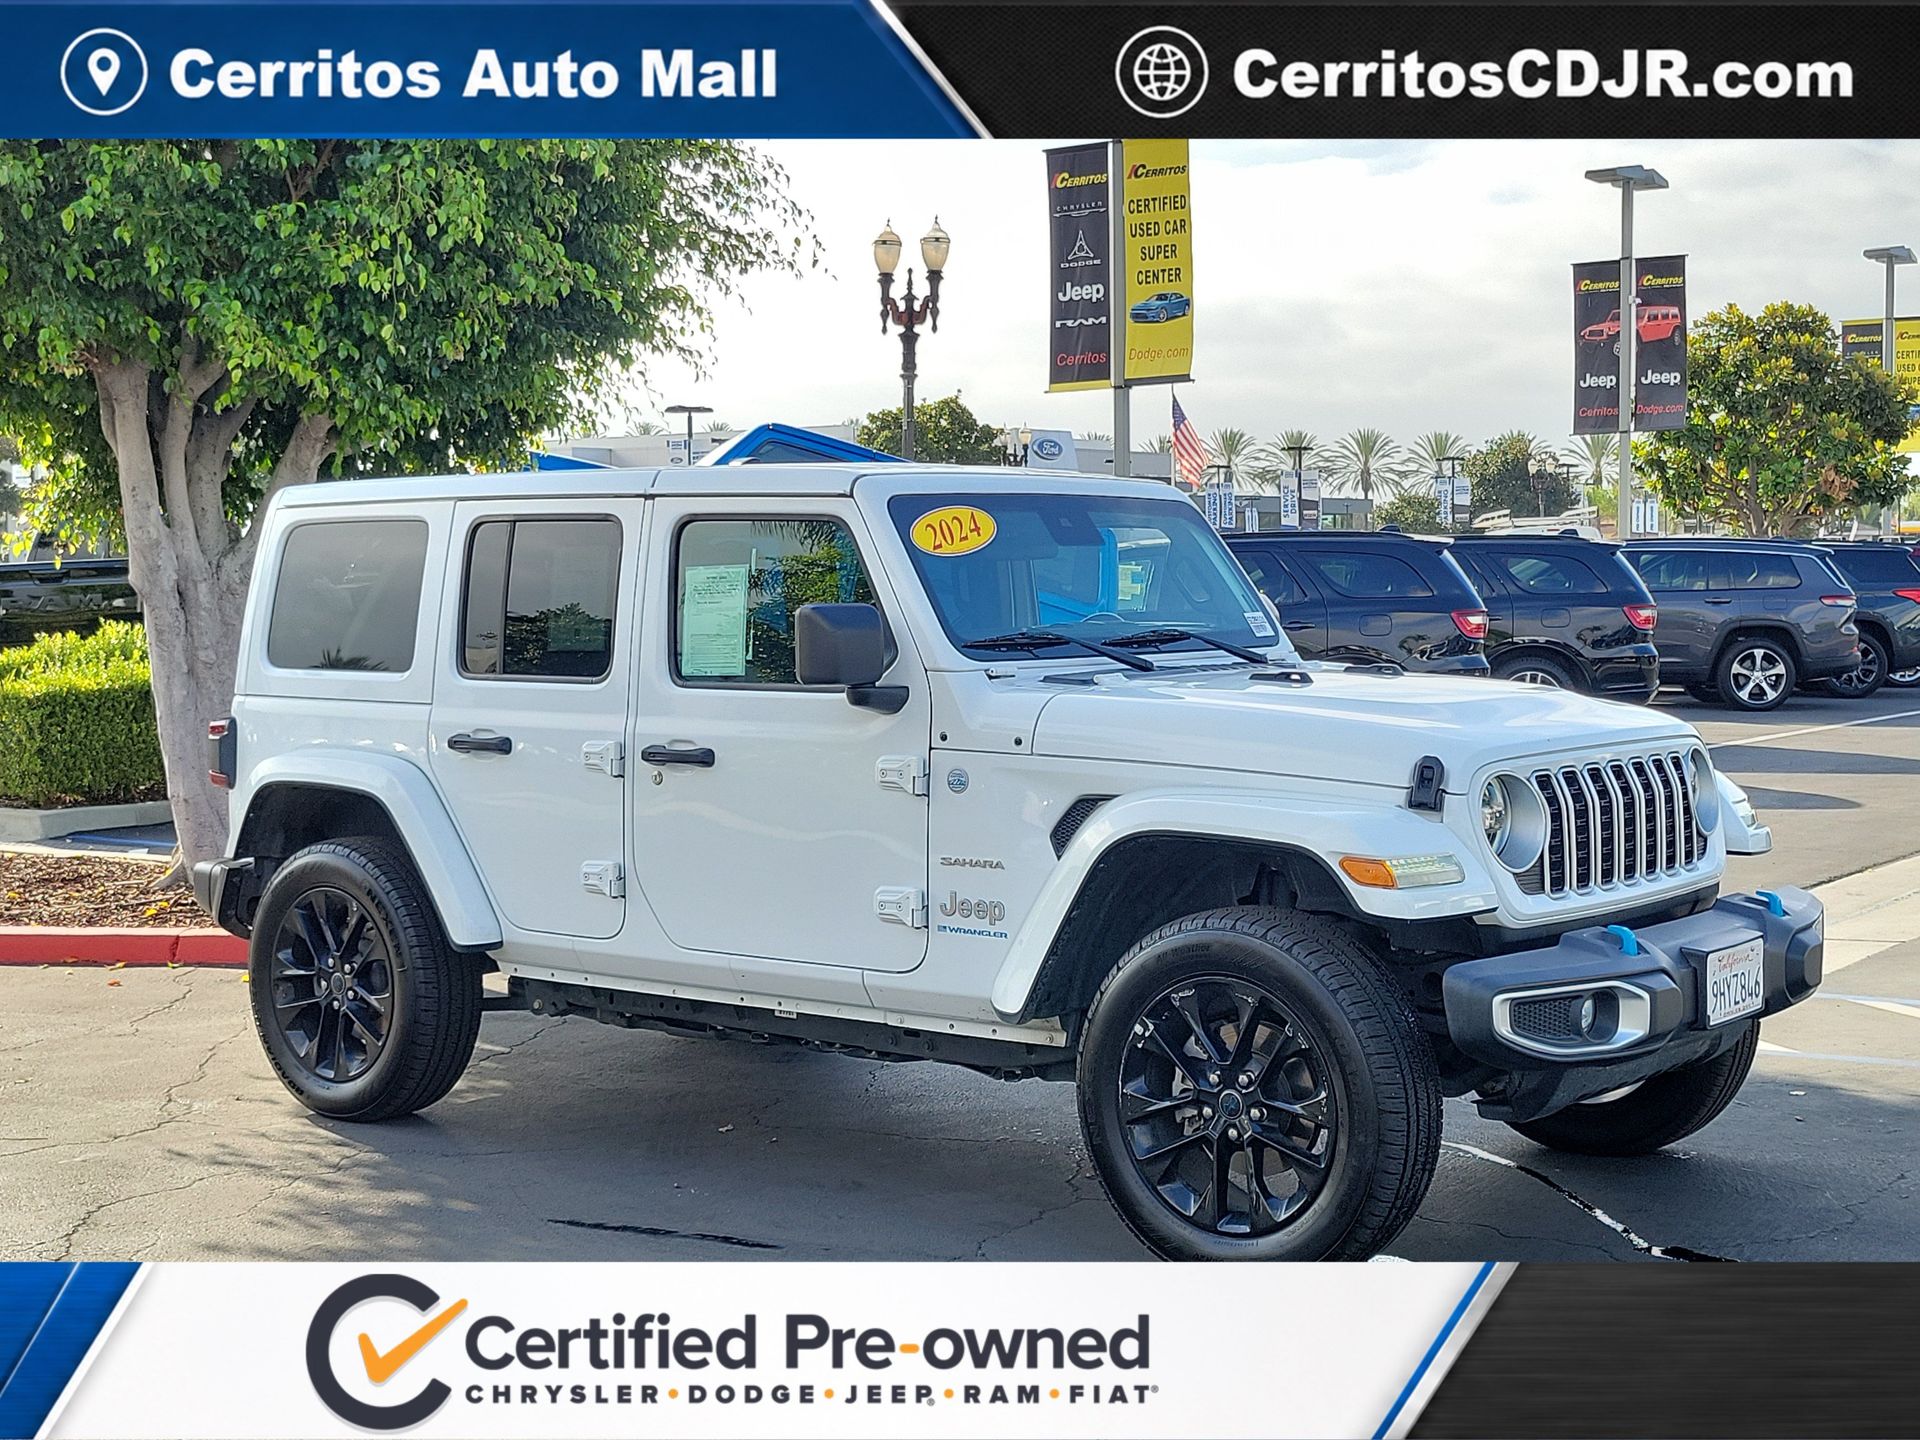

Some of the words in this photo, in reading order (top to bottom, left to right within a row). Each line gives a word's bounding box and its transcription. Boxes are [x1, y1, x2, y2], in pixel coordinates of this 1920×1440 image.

[1056, 201, 1102, 212] CHRYSLER
[1128, 194, 1187, 214] CERTIFIED
[1129, 221, 1161, 238] USED
[1164, 218, 1187, 235] CAR
[1140, 244, 1178, 261] SUPER
[1060, 259, 1102, 268] DODGE
[1136, 267, 1182, 285] CENTER
[1057, 281, 1105, 303] Jeep
[1055, 316, 1107, 328] RAM
[1056, 351, 1107, 366] Cerritos
[1128, 347, 1189, 362] Dodge.com
[1896, 363, 1916, 372] USED
[1579, 373, 1617, 389] Jeep
[1640, 369, 1681, 386] Jeep
[1579, 406, 1619, 417] Cerritos
[1636, 403, 1684, 415] Dodge.com
[1042, 441, 1060, 455] Ford
[1282, 484, 1290, 519] SERVICE
[1289, 488, 1297, 514] DRIVE
[924, 511, 982, 551] 2024
[939, 857, 1006, 870] SAHARA
[938, 889, 1007, 927] Jeep
[947, 925, 1009, 940] WRANGLER
[1711, 965, 1761, 1015] 9HYZ846
